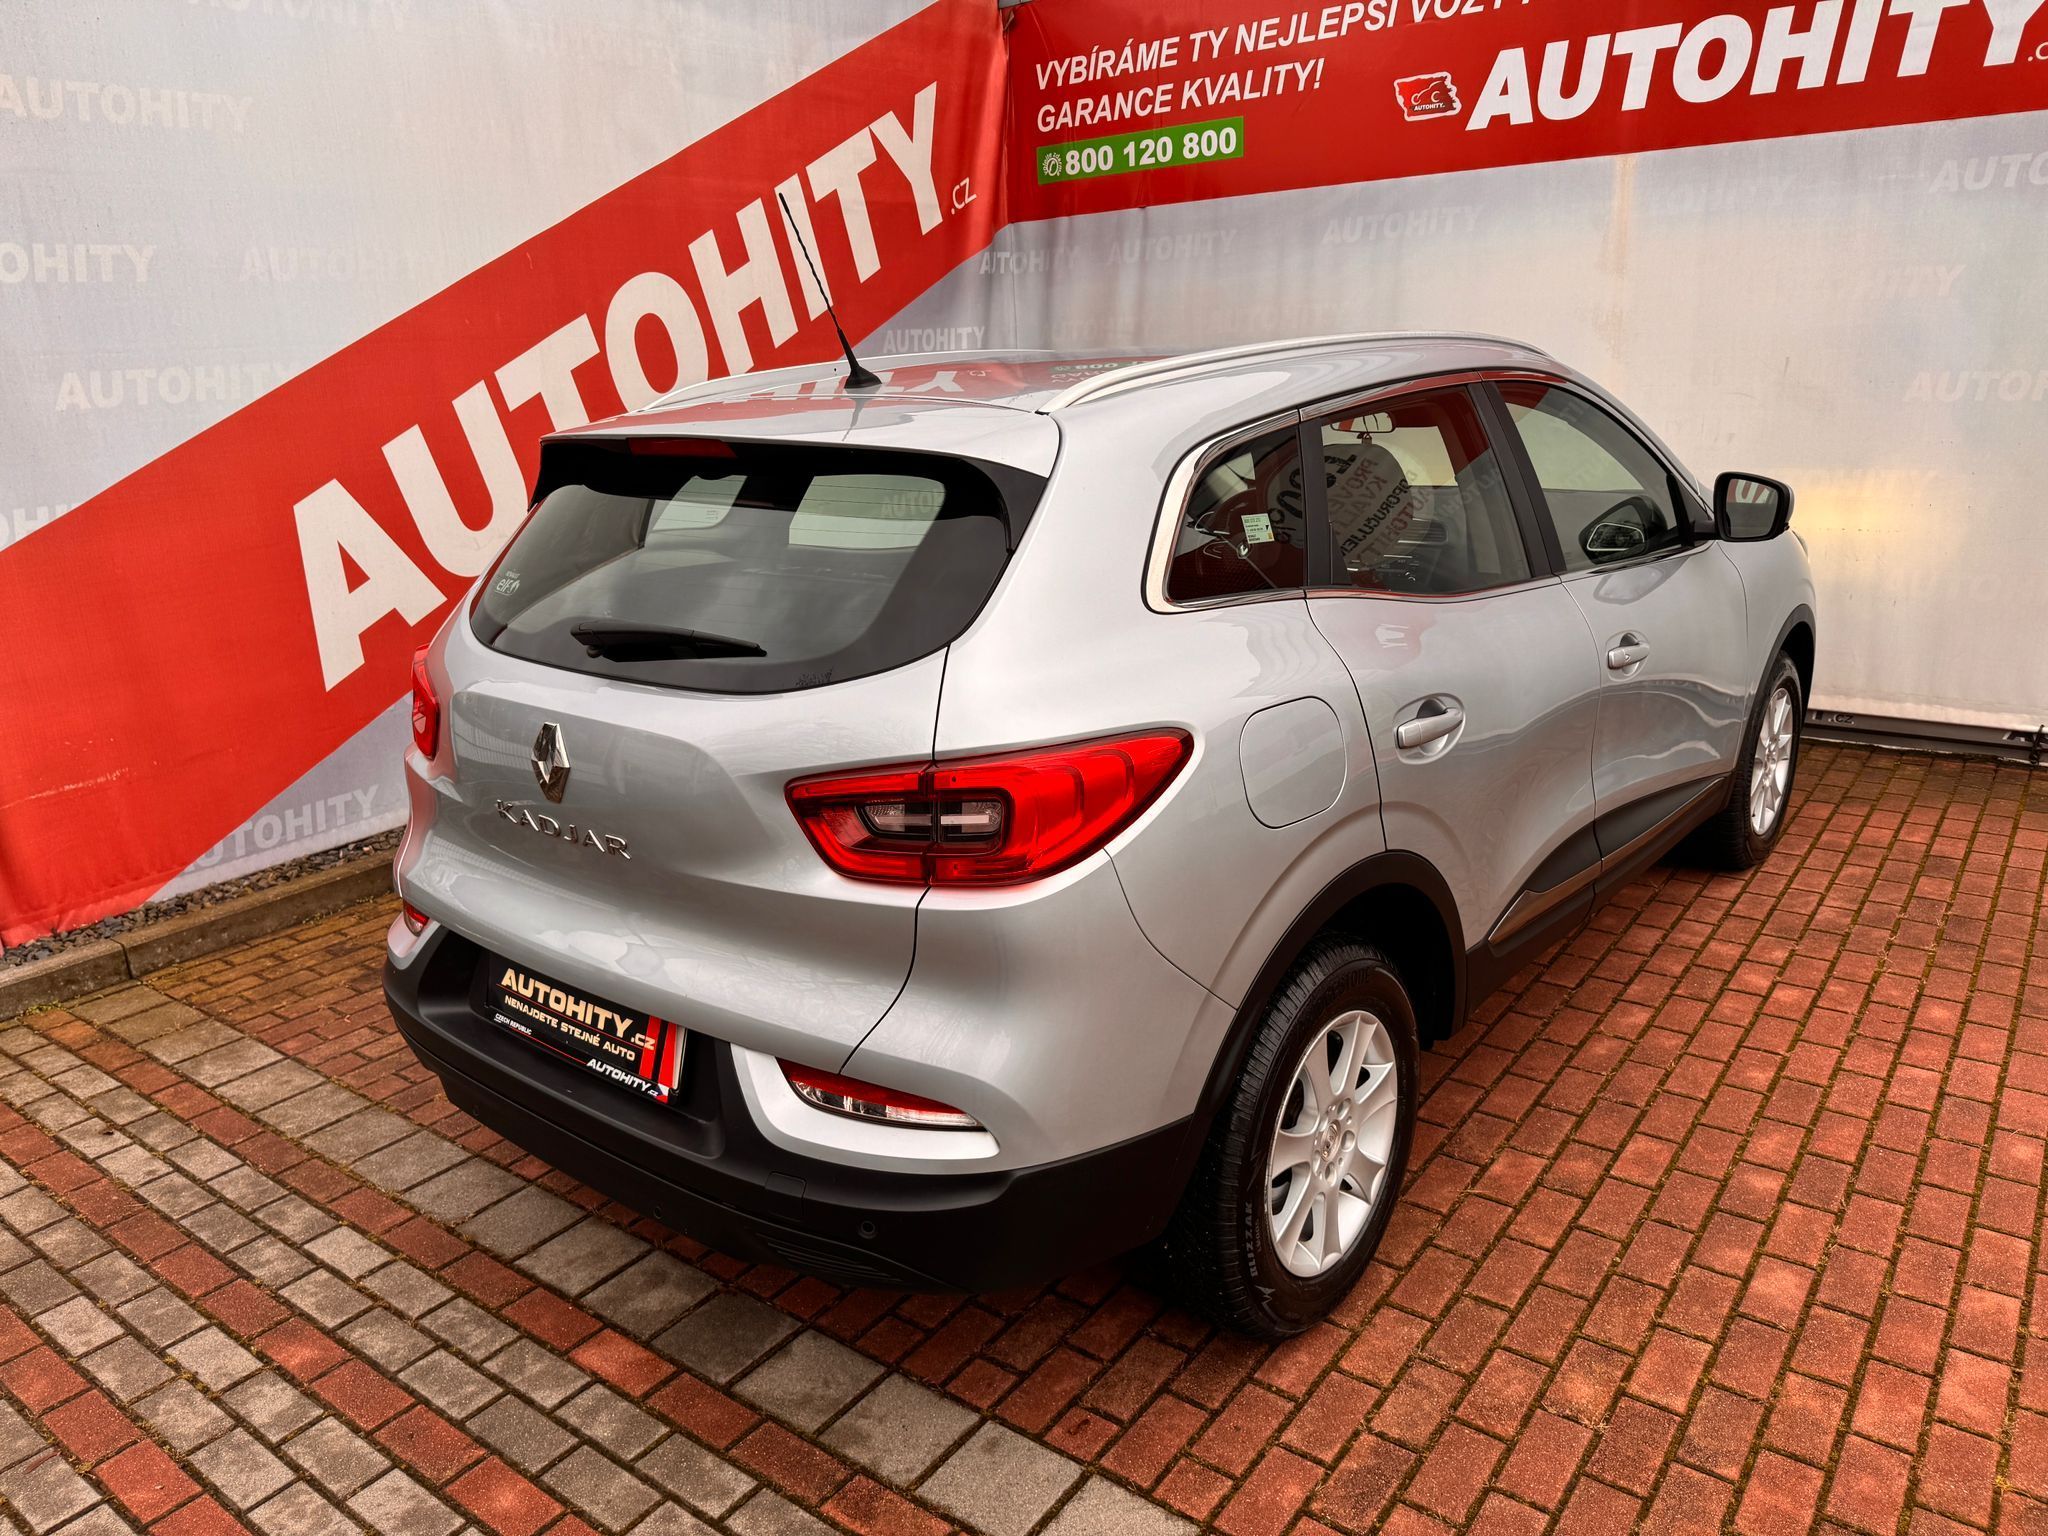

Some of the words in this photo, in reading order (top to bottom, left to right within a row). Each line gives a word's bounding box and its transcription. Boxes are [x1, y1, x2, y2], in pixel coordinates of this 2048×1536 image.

[1035, 36, 1181, 90] VYBÍRÁME
[1189, 26, 1229, 62] TY
[1037, 83, 1174, 133] GARANCE
[1180, 58, 1325, 110] KVALITY!
[1065, 145, 1113, 176] 800
[1123, 136, 1173, 168] 120
[1183, 127, 1236, 159] 800
[883, 326, 985, 354] AUTOHITY
[184, 784, 379, 872] UTOHITY
[495, 798, 633, 860] KADJAR
[494, 1012, 510, 1025] CZECH
[509, 1019, 532, 1036] REPUBLIC
[504, 995, 559, 1028] NENAJDETE
[560, 1021, 600, 1047] STEJNÉ
[602, 1041, 636, 1062] AUTO
